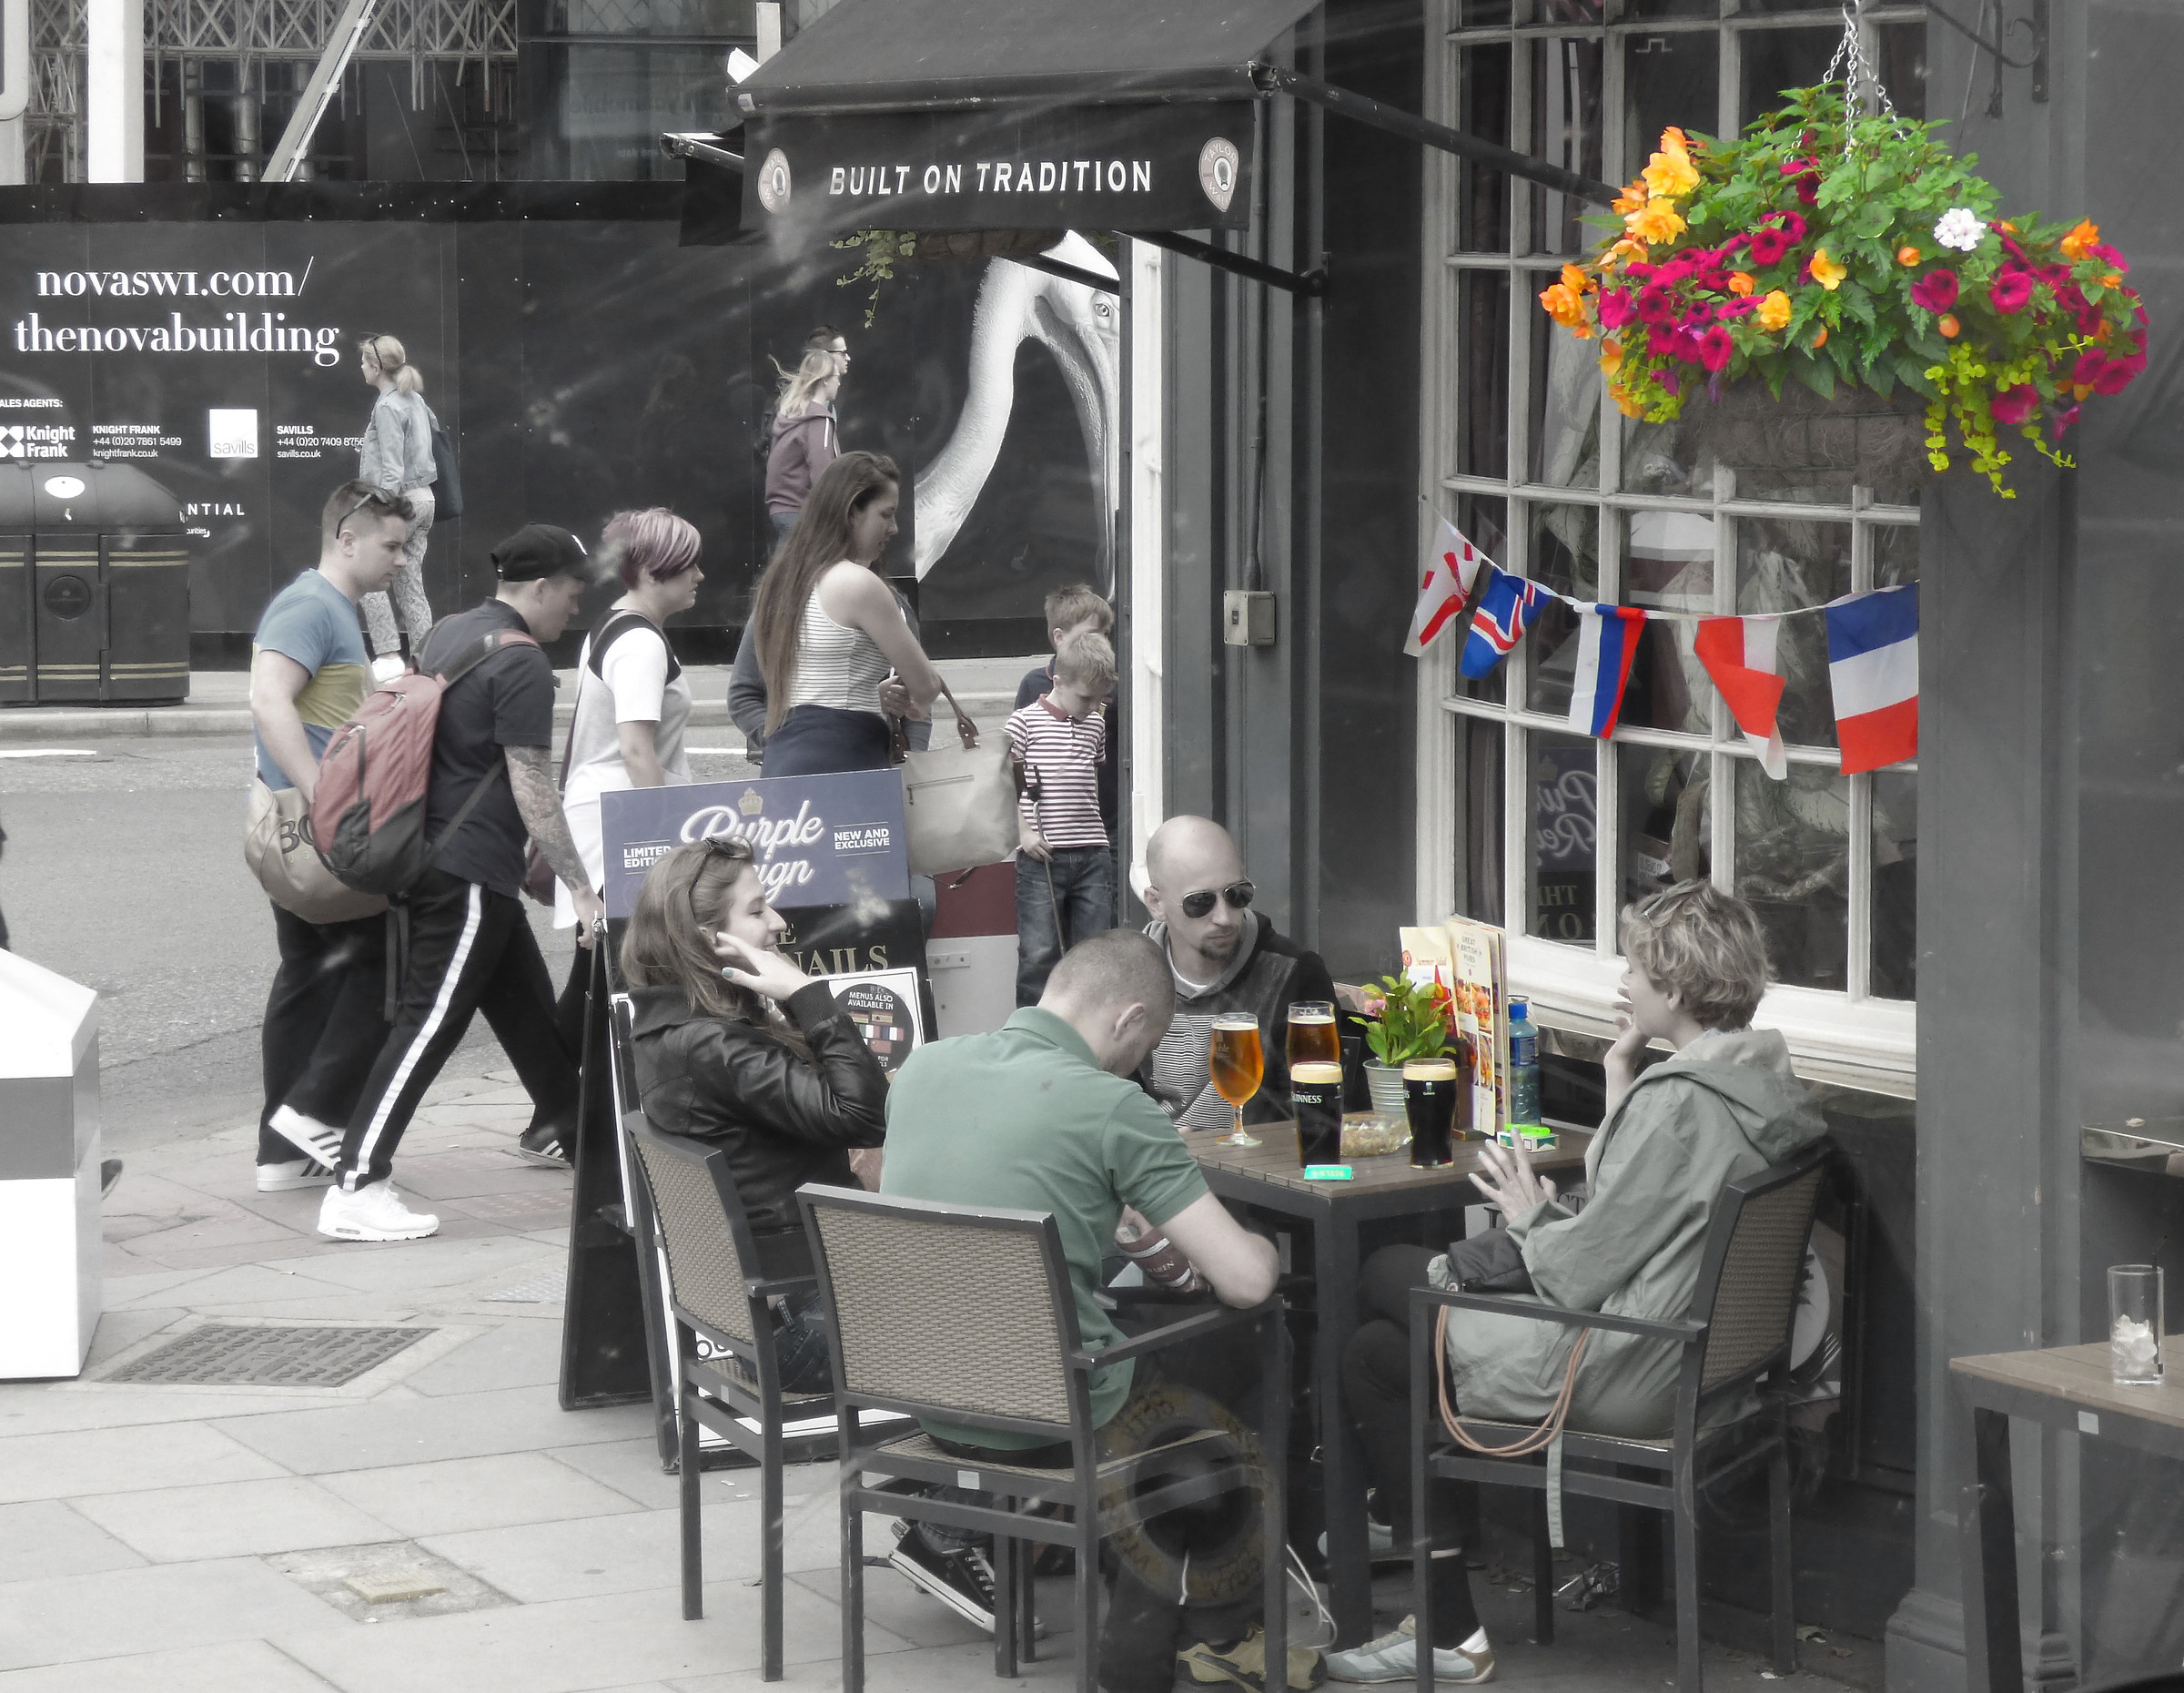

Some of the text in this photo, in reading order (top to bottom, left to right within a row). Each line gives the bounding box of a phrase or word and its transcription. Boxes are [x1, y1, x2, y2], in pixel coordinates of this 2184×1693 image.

[1204, 142, 1238, 164] TAYLOR
[829, 160, 1152, 196] BUILT ON TRADITION
[14, 311, 340, 367] thenovabuilding
[23, 399, 64, 408] AGENTS:
[26, 425, 76, 444] Knight
[92, 425, 161, 434] KNIGHT FRANK
[277, 425, 314, 435] SAVILLS
[93, 436, 182, 447] +44 (0)20 7861 5499
[213, 440, 256, 455] savills
[277, 438, 294, 446] +44
[296, 437, 318, 447] (0)20
[320, 437, 341, 446] 7409
[26, 442, 68, 458] Frank
[93, 448, 158, 460] knightfrank.co.uk
[277, 449, 321, 459] savills.co.uk
[187, 502, 246, 516] NTIAL
[680, 799, 824, 855] Purple
[834, 828, 890, 842] NEW AND
[834, 836, 891, 851] EXCLUSIVE
[623, 857, 658, 868] EDITI
[753, 852, 815, 904] ign
[848, 991, 894, 1003] MENUS ALSO
[847, 999, 894, 1010] AVAILABLE IN
